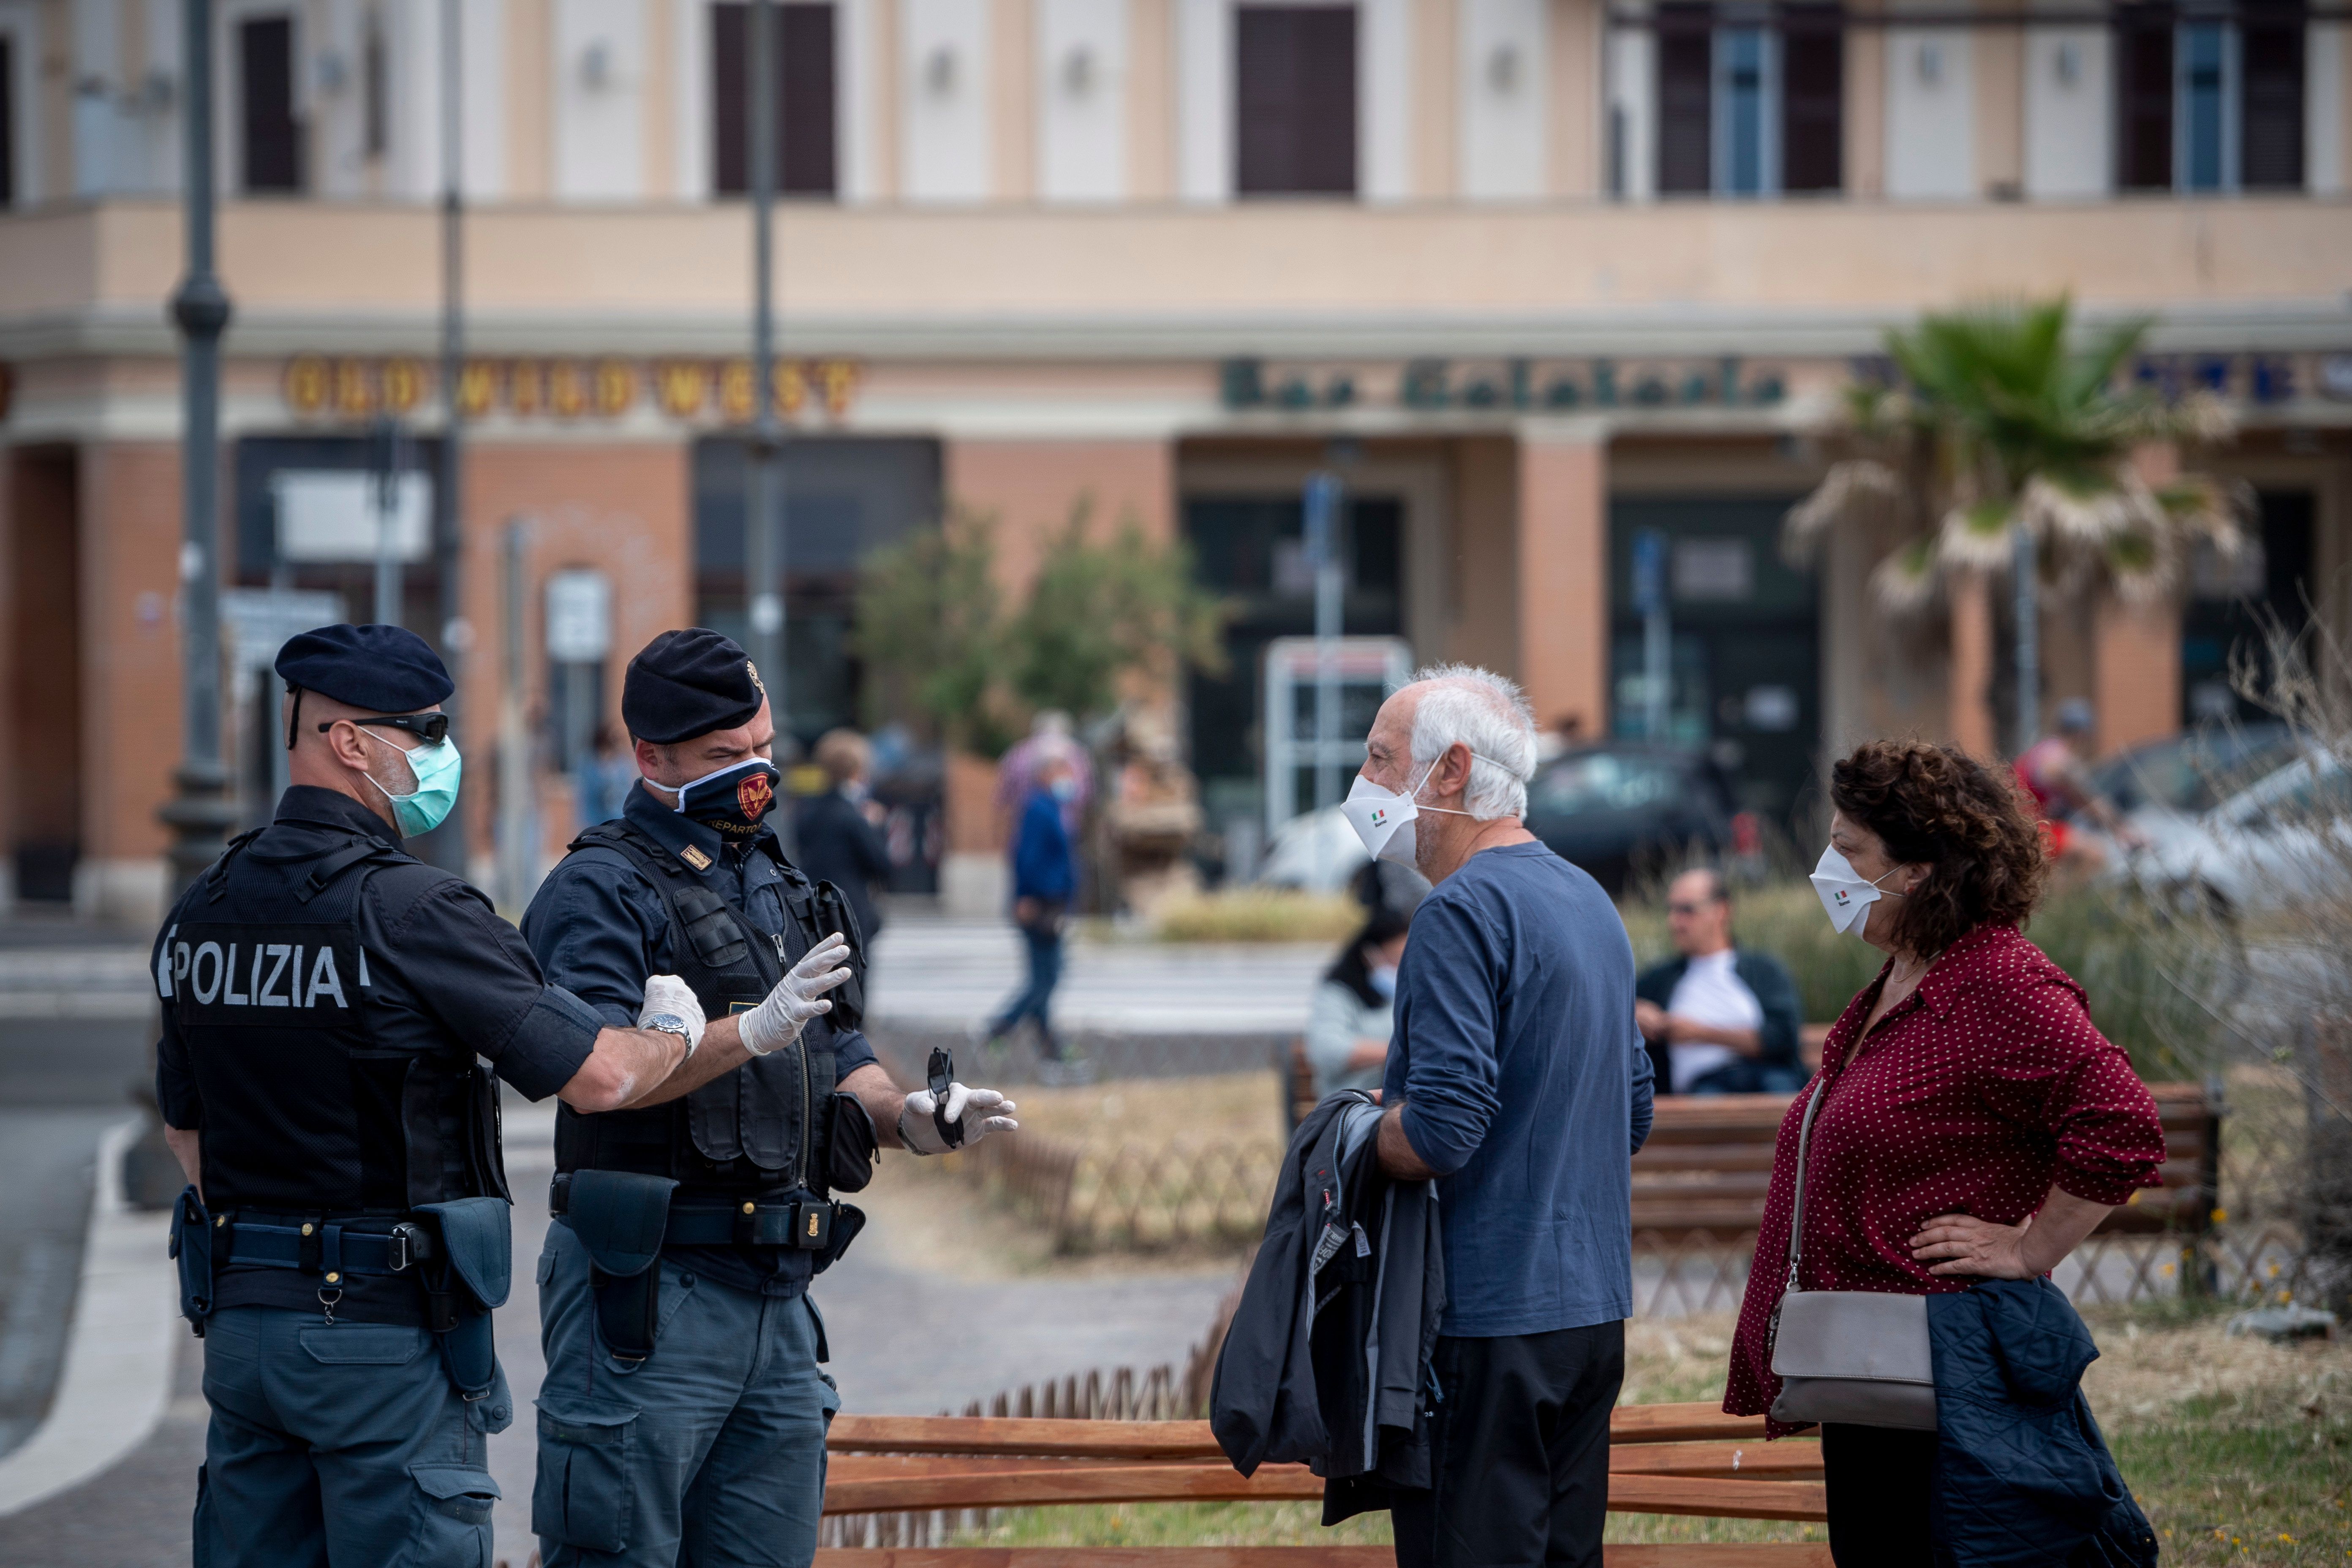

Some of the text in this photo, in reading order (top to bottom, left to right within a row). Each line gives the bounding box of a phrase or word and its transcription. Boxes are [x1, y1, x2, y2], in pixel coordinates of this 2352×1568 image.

[282, 352, 861, 417] OLD WILD WEST
[174, 941, 348, 1008] POLIZIA
